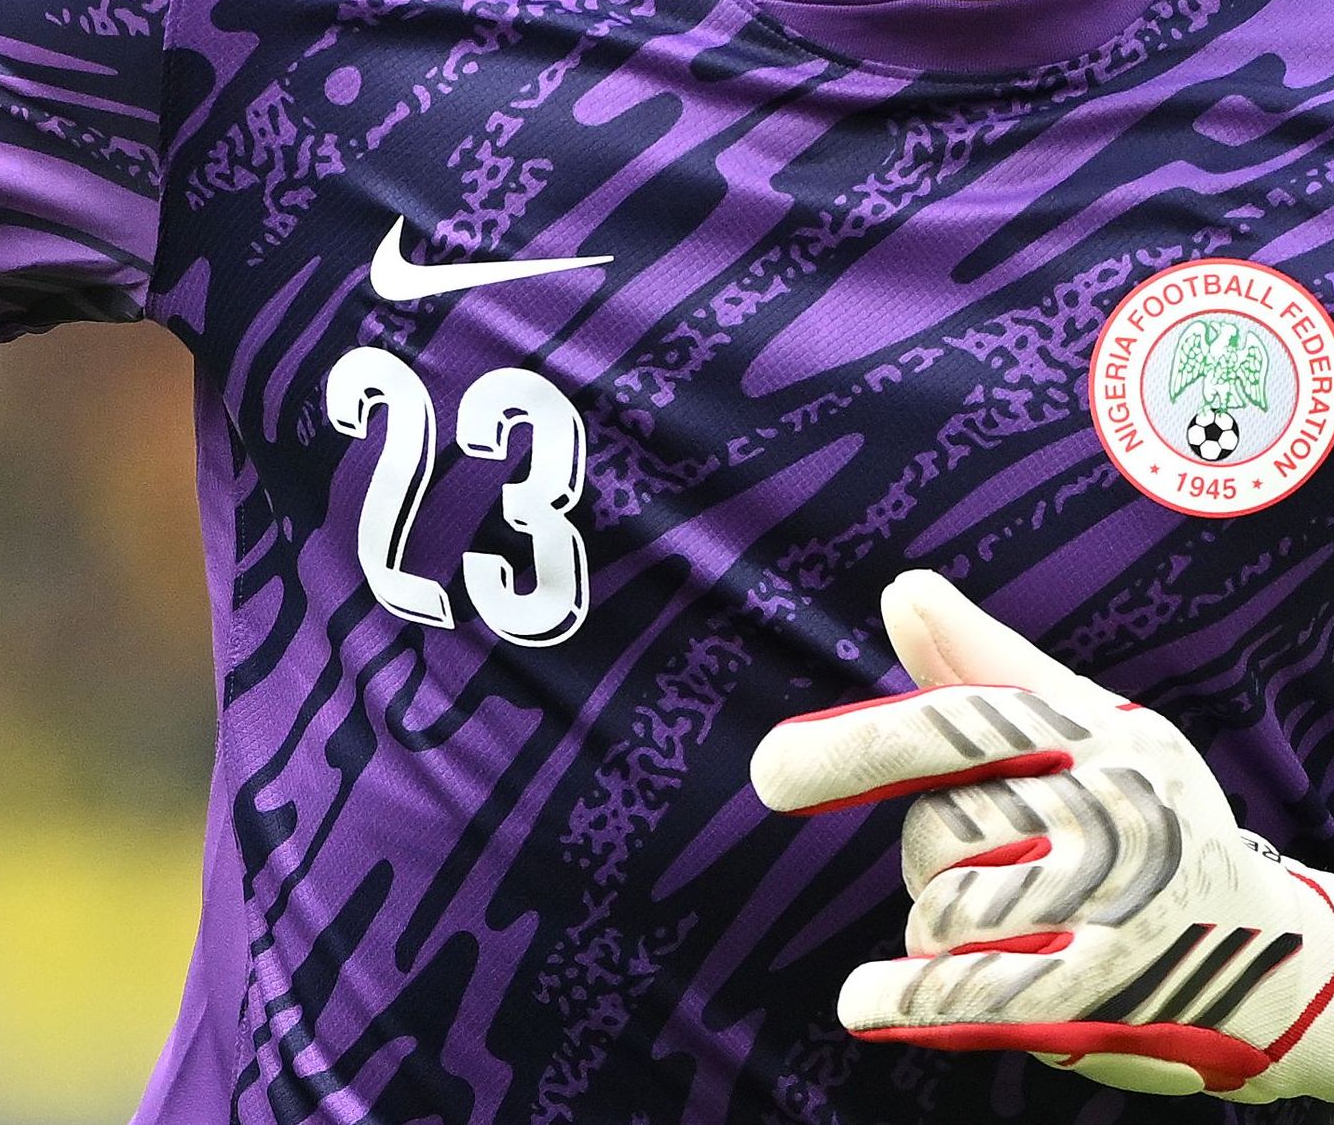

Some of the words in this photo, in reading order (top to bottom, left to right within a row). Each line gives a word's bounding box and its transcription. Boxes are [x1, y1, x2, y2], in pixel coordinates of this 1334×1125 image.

[1105, 334, 1144, 453] NIGERIA
[1127, 274, 1274, 333] FOOTBALL
[1273, 301, 1333, 478] FEDERATION
[326, 346, 590, 648] 23
[1175, 472, 1237, 500] 1945
